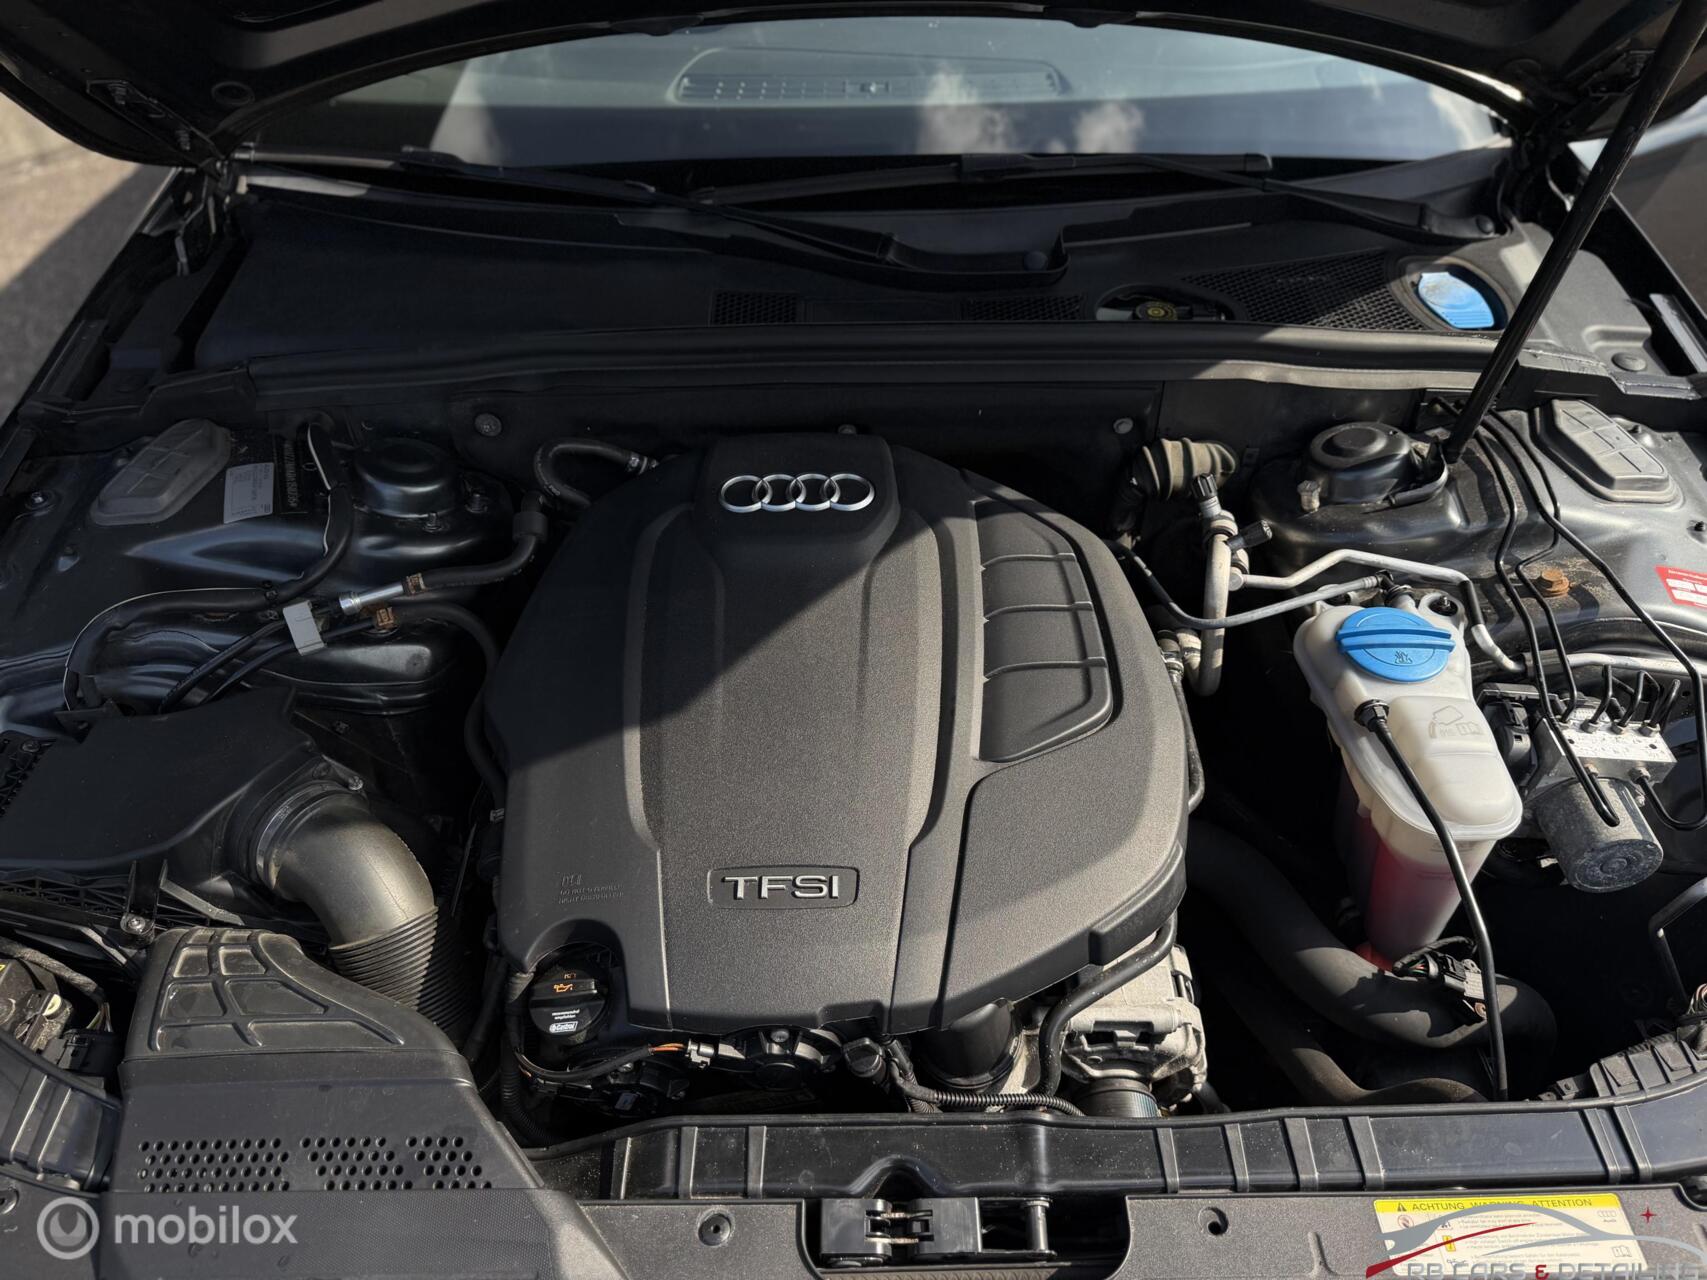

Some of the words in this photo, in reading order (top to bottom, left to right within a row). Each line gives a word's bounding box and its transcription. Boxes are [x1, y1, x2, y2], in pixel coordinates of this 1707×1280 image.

[721, 875, 839, 900] TFSI
[1412, 1202, 1465, 1211] ACHTUNG
[1532, 1199, 1592, 1209] ATTENTION
